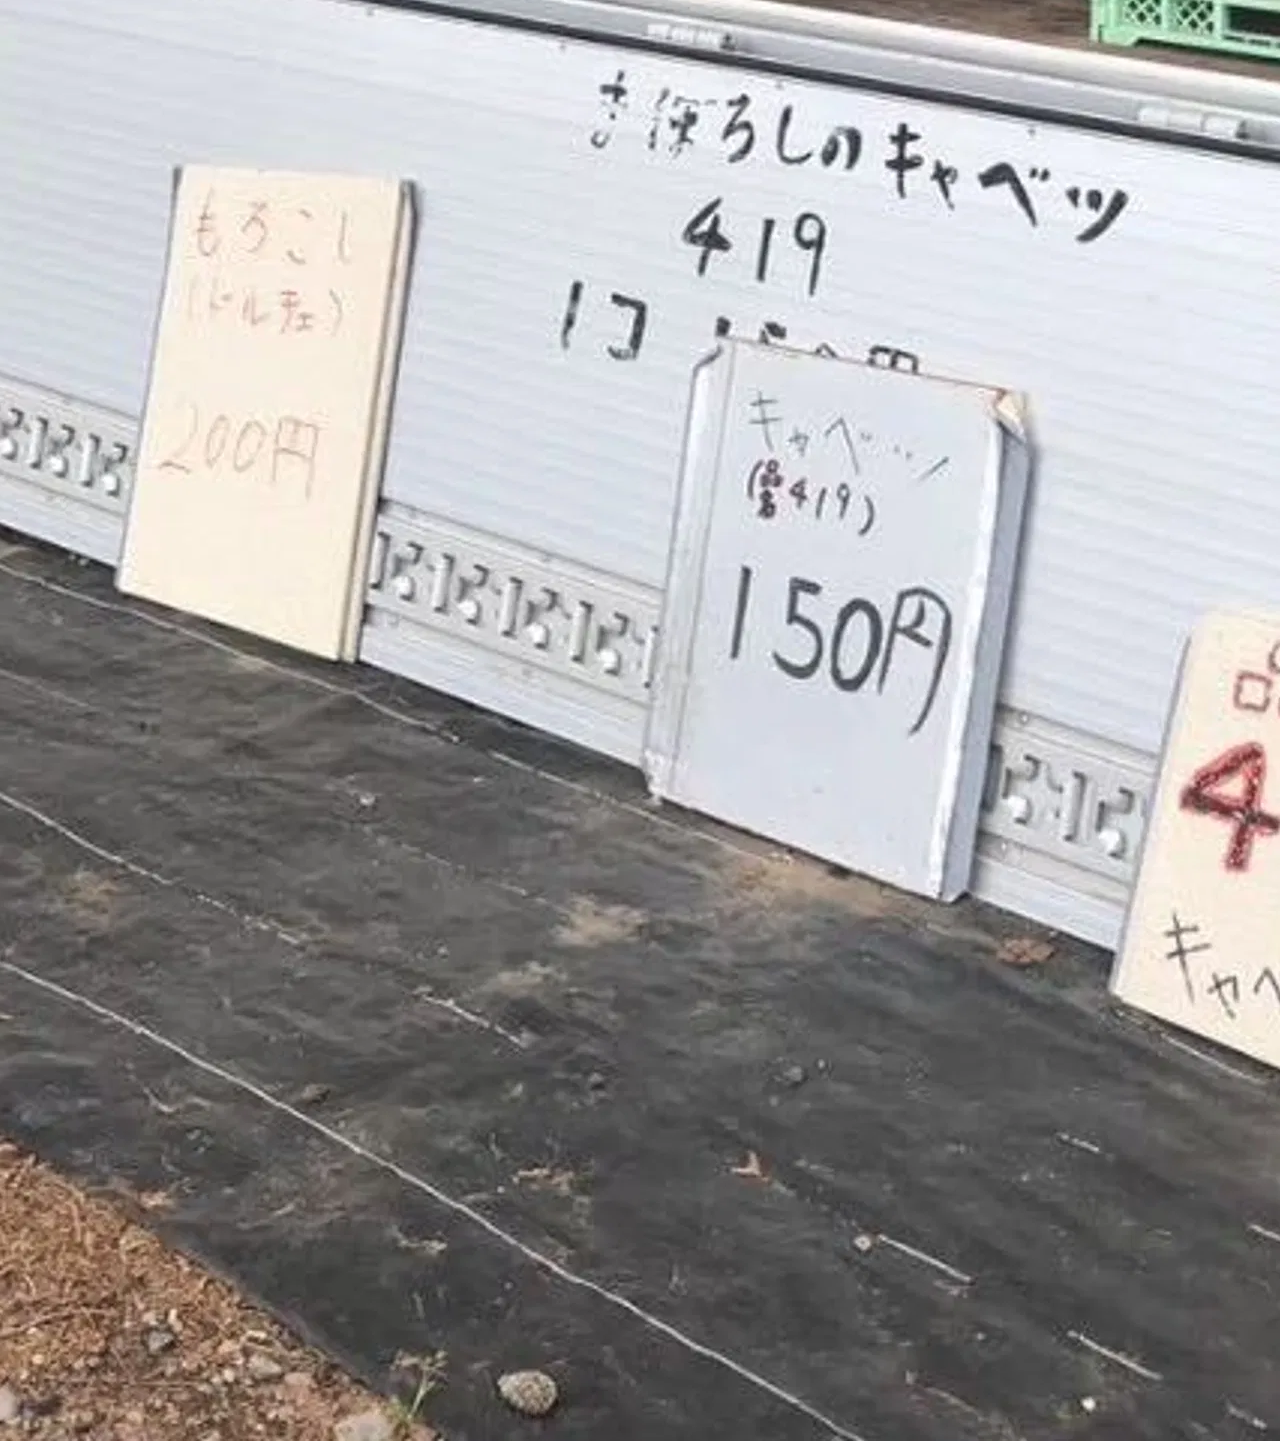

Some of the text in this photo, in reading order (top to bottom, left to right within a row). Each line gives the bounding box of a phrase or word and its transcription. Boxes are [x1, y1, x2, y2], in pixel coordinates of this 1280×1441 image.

[196, 187, 352, 266] もろこし
[682, 197, 827, 295] 419
[157, 399, 323, 502] 200円
[748, 390, 950, 483] キャベツ
[730, 564, 953, 738] 150円
